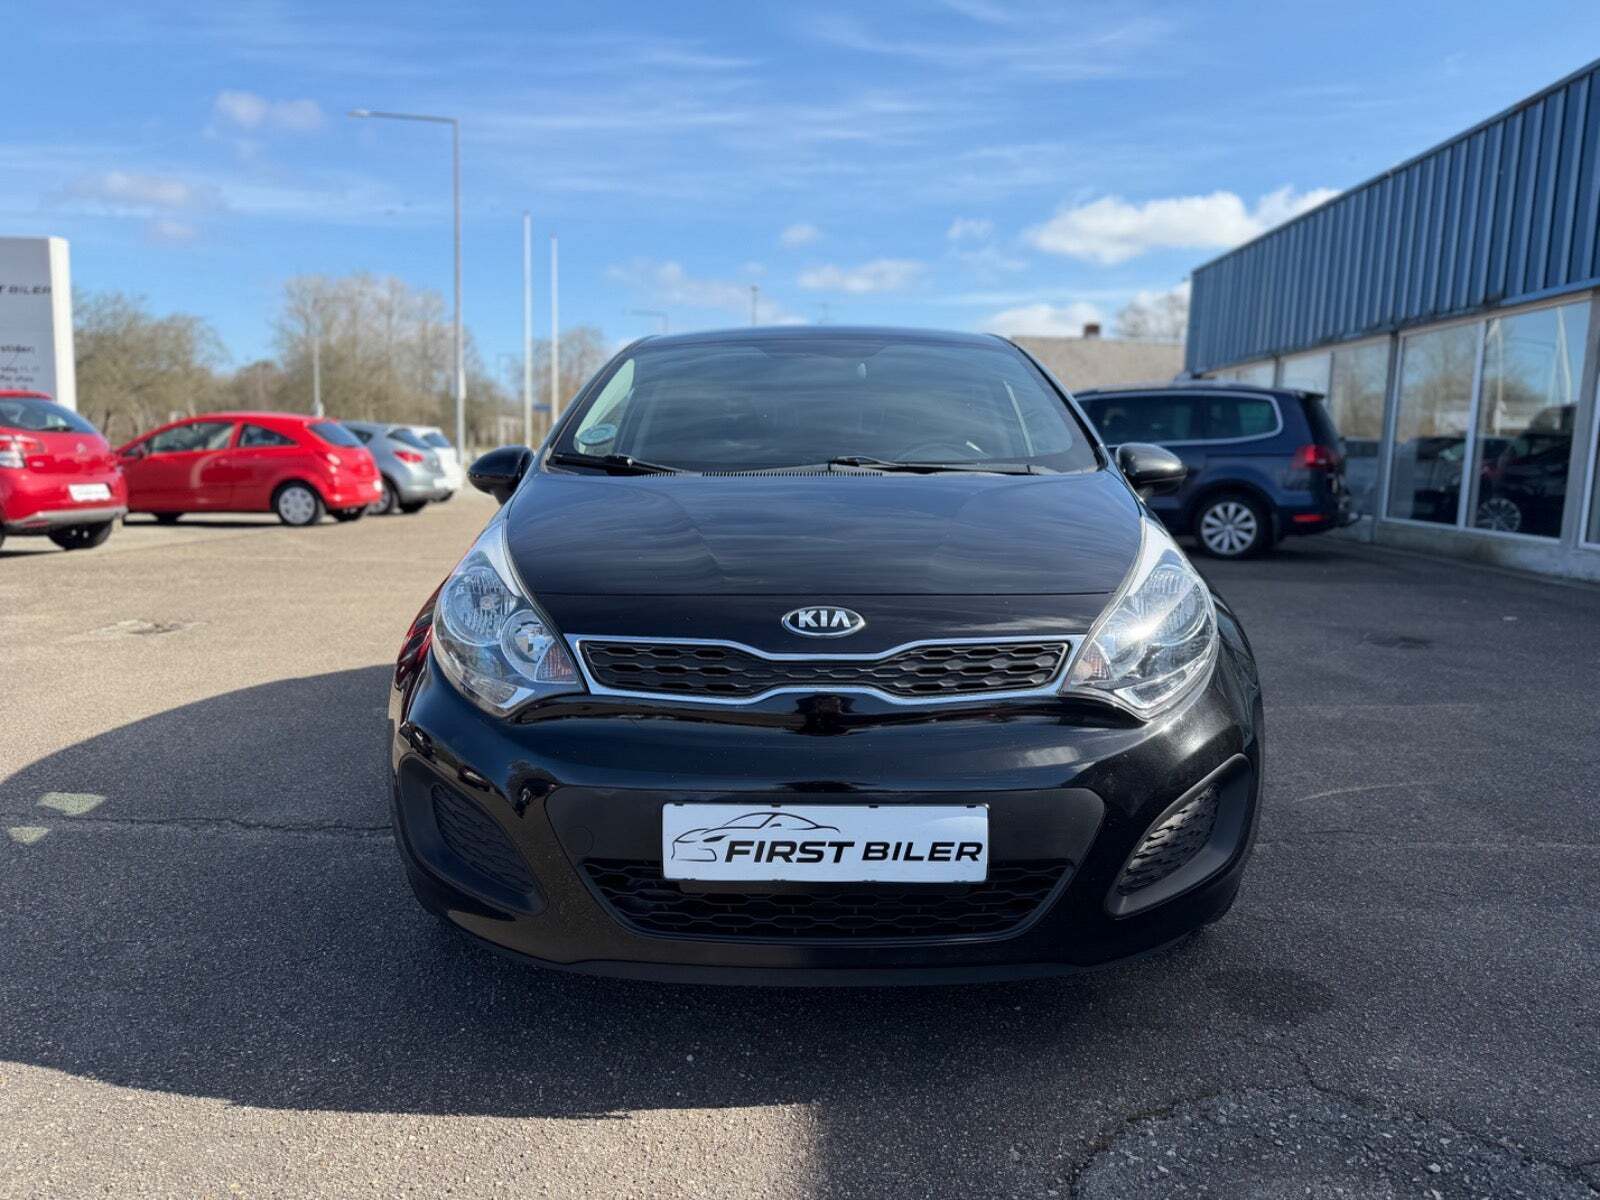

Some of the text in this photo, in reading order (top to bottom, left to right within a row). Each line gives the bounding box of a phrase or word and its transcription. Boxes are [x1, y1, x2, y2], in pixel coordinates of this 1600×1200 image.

[797, 610, 851, 628] KIA
[724, 840, 983, 864] FIRST BILER
